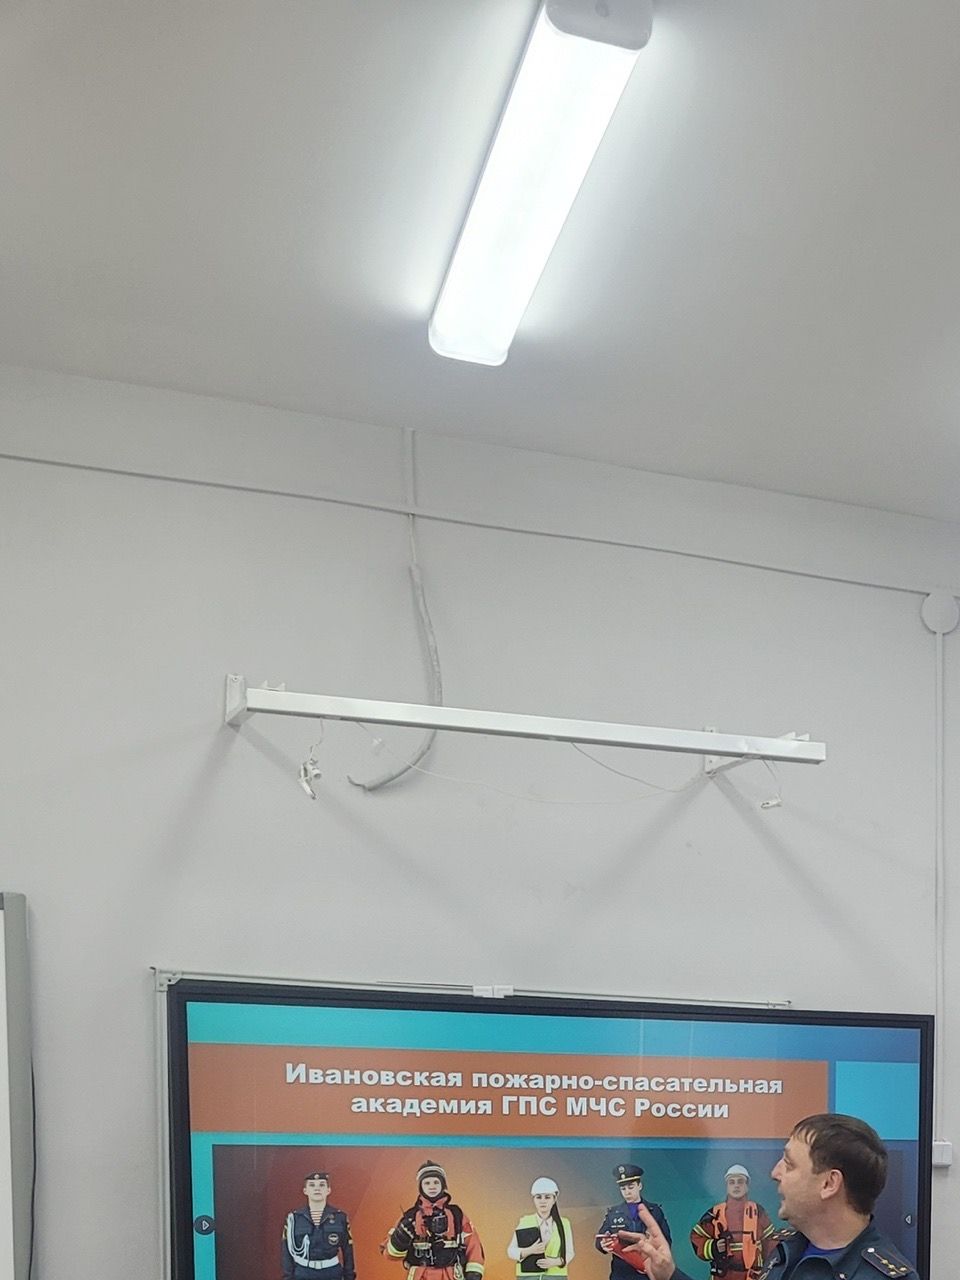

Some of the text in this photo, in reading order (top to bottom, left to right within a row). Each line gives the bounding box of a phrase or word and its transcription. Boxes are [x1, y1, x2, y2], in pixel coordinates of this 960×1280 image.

[285, 1062, 783, 1094] Ивановская пожарно-спасательная
[351, 1095, 730, 1119] академия ГПС МЧС России
